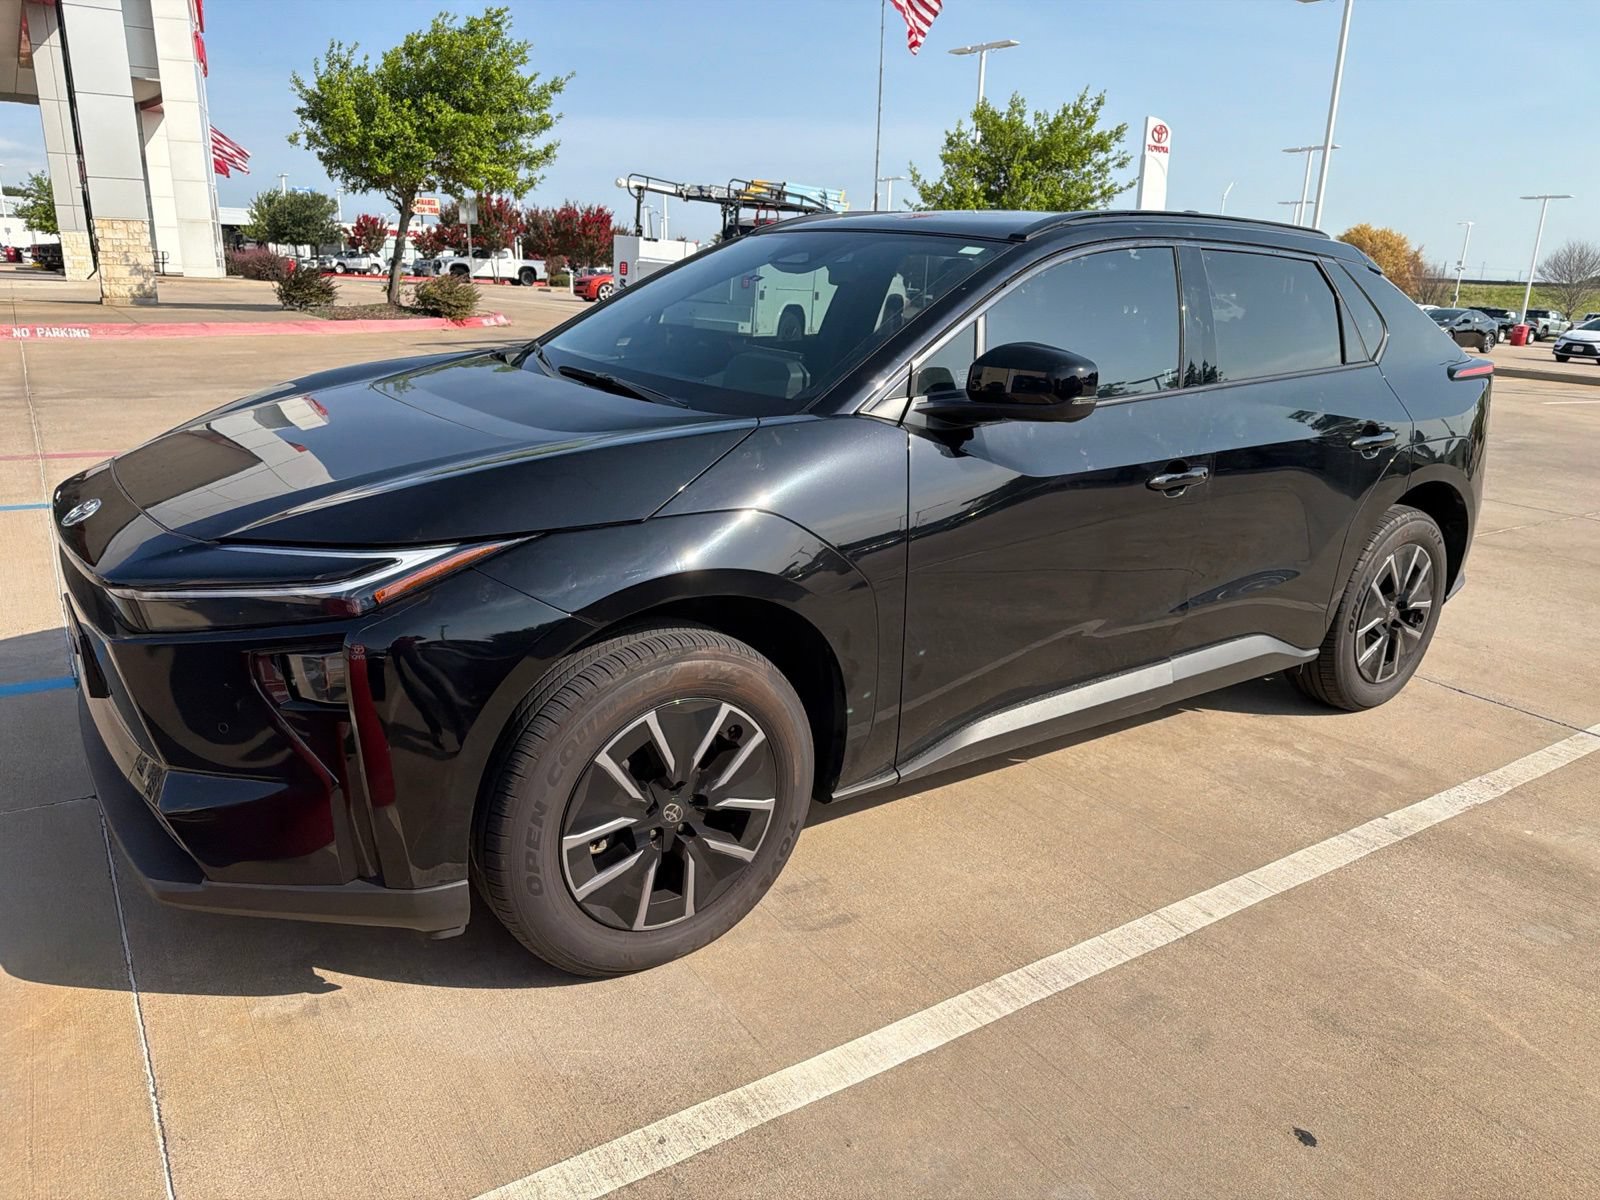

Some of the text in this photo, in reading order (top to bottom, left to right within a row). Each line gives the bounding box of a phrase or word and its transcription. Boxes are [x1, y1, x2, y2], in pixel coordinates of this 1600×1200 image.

[1147, 144, 1169, 154] TOYOTA
[12, 327, 90, 338] NO PARKING
[524, 798, 549, 897] OPEN
